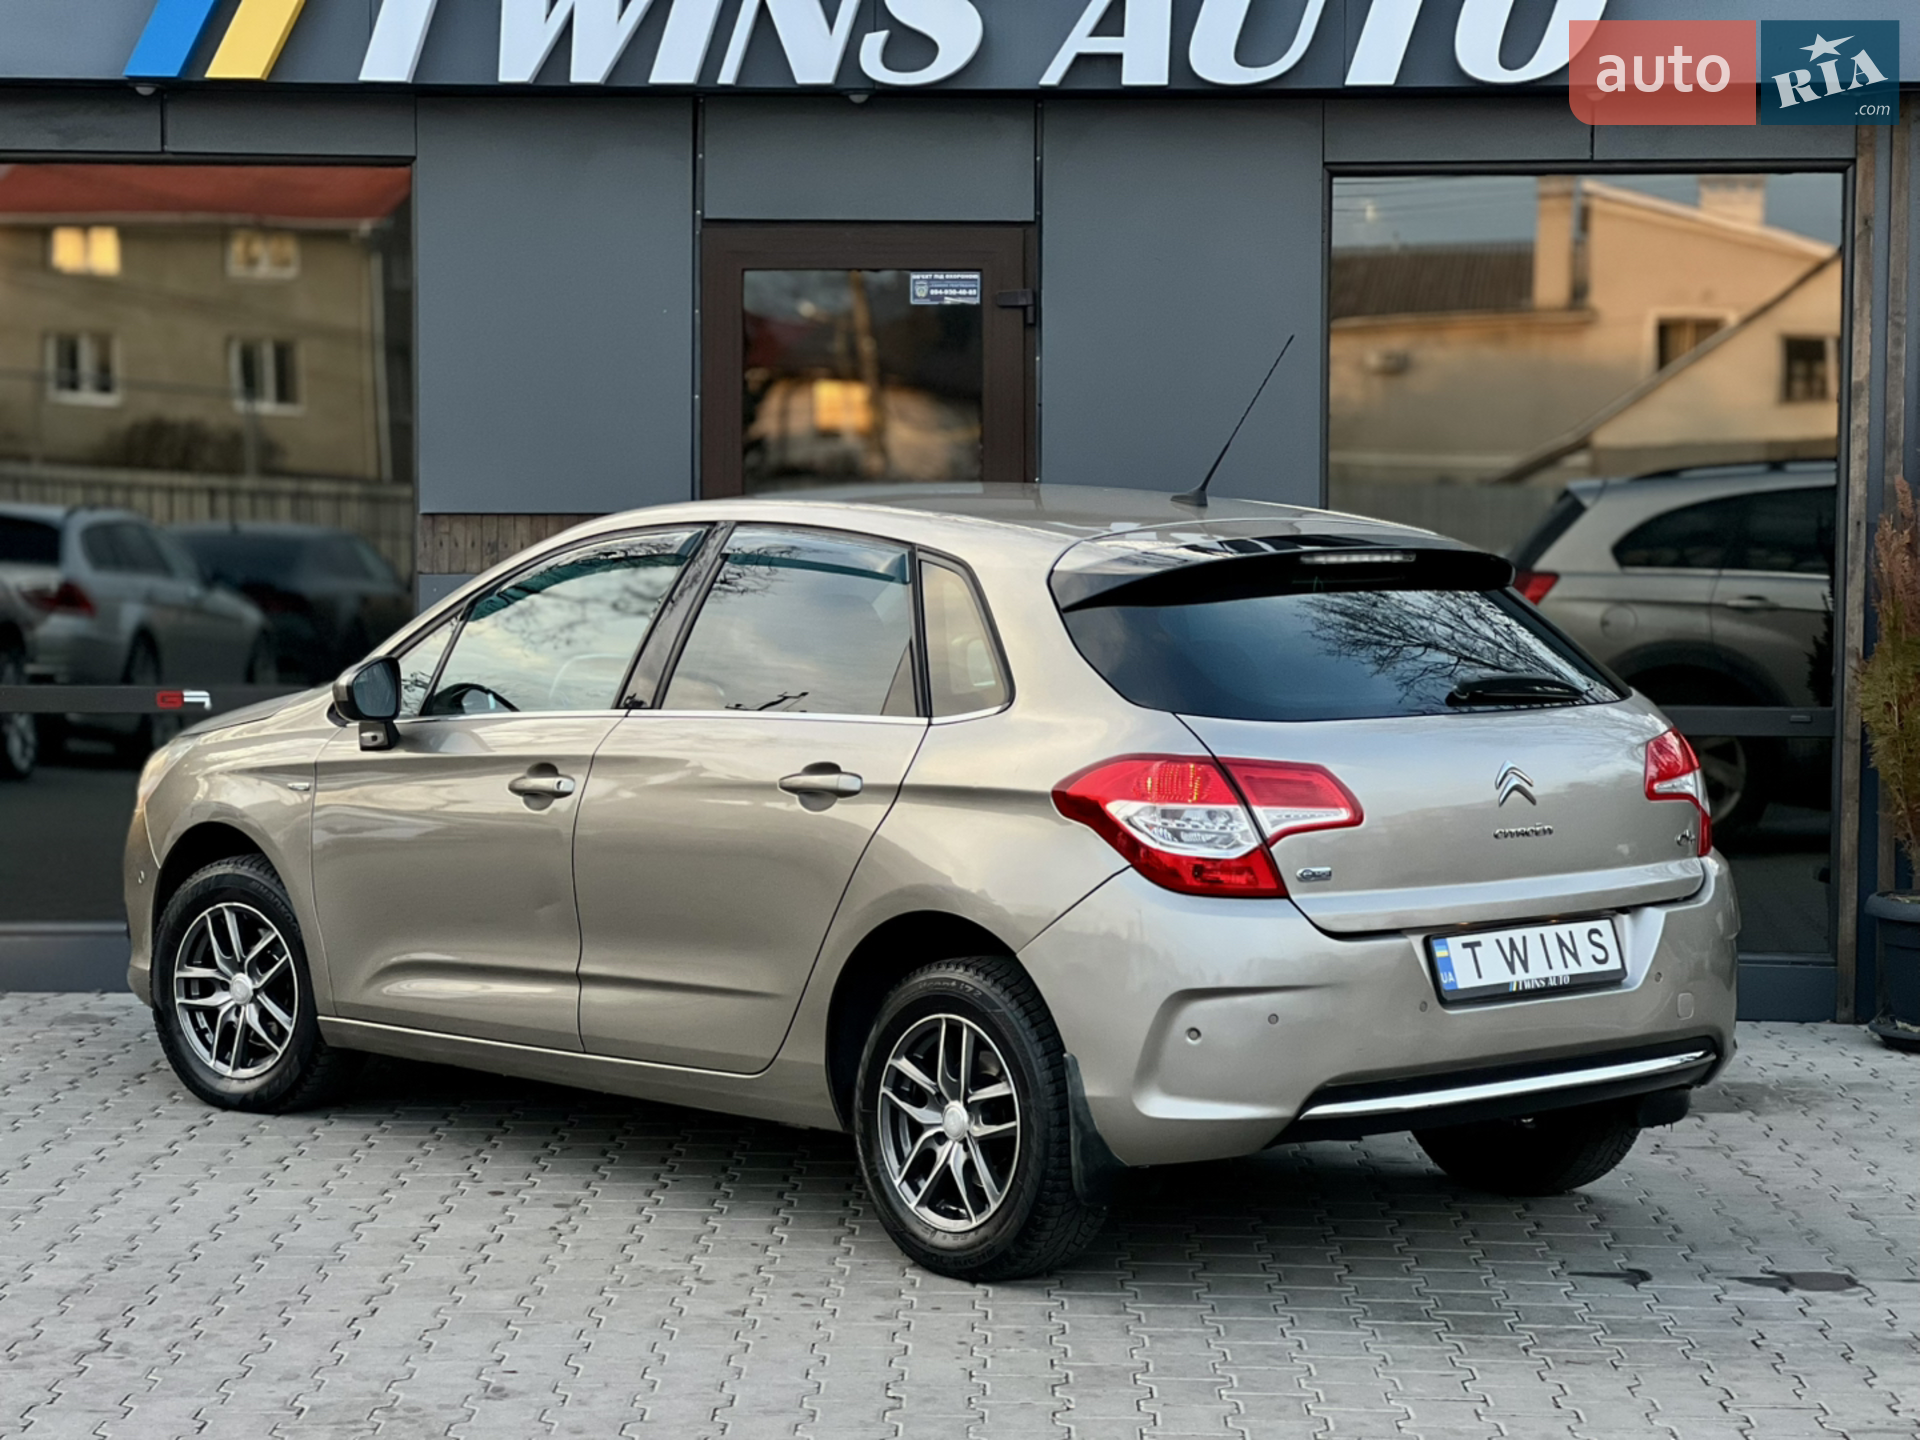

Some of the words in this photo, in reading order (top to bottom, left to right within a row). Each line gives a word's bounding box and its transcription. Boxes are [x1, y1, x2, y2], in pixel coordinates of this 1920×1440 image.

[1461, 928, 1610, 980] TWINS
[1440, 971, 1455, 985] UA
[1518, 977, 1546, 992] TWINS
[1547, 975, 1571, 987] AUTO
